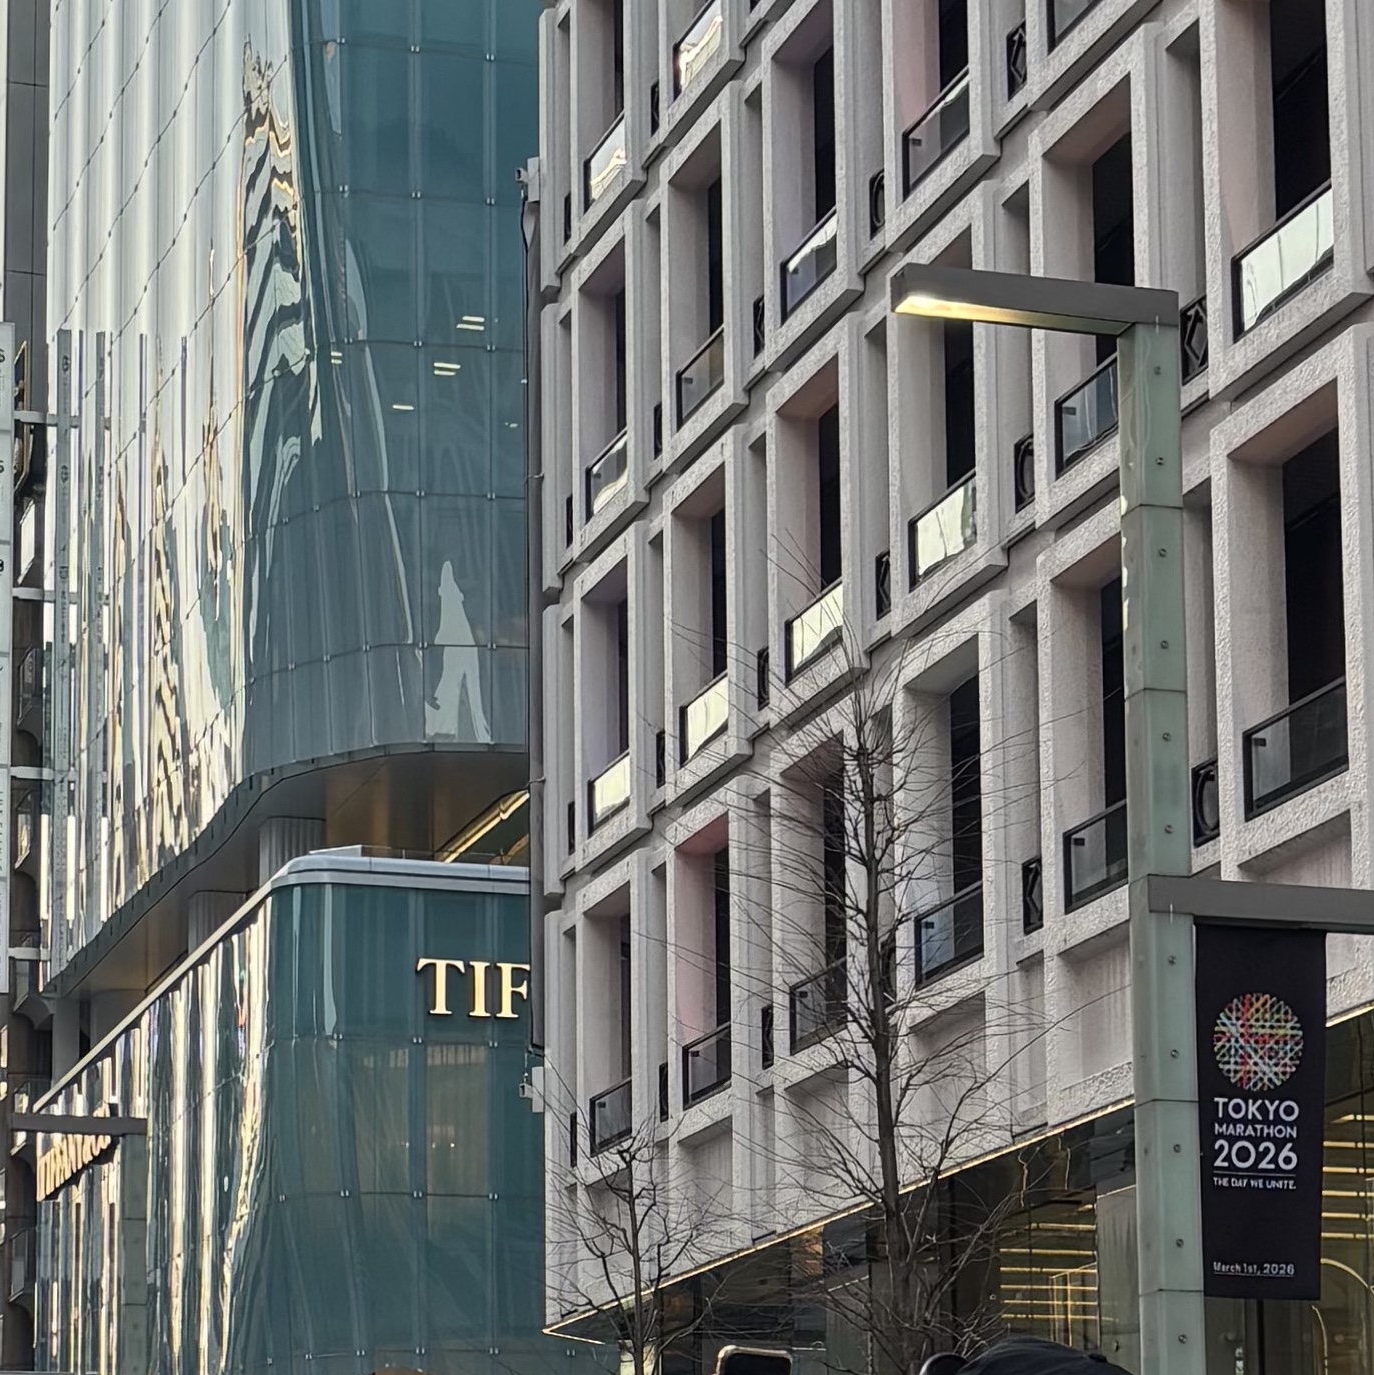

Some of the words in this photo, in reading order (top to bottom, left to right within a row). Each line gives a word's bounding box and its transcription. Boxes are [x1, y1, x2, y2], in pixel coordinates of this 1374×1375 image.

[416, 957, 531, 1018] TIF
[1213, 1096, 1300, 1122] TOKYO
[1214, 1122, 1298, 1139] MARATHON
[1213, 1139, 1298, 1171] 2026
[1213, 1177, 1230, 1188] THE
[1231, 1177, 1249, 1188] DAY
[1250, 1179, 1264, 1189] WE
[1266, 1180, 1297, 1190] UNITE.
[1213, 1261, 1242, 1274] March
[1263, 1263, 1295, 1276] 2026
